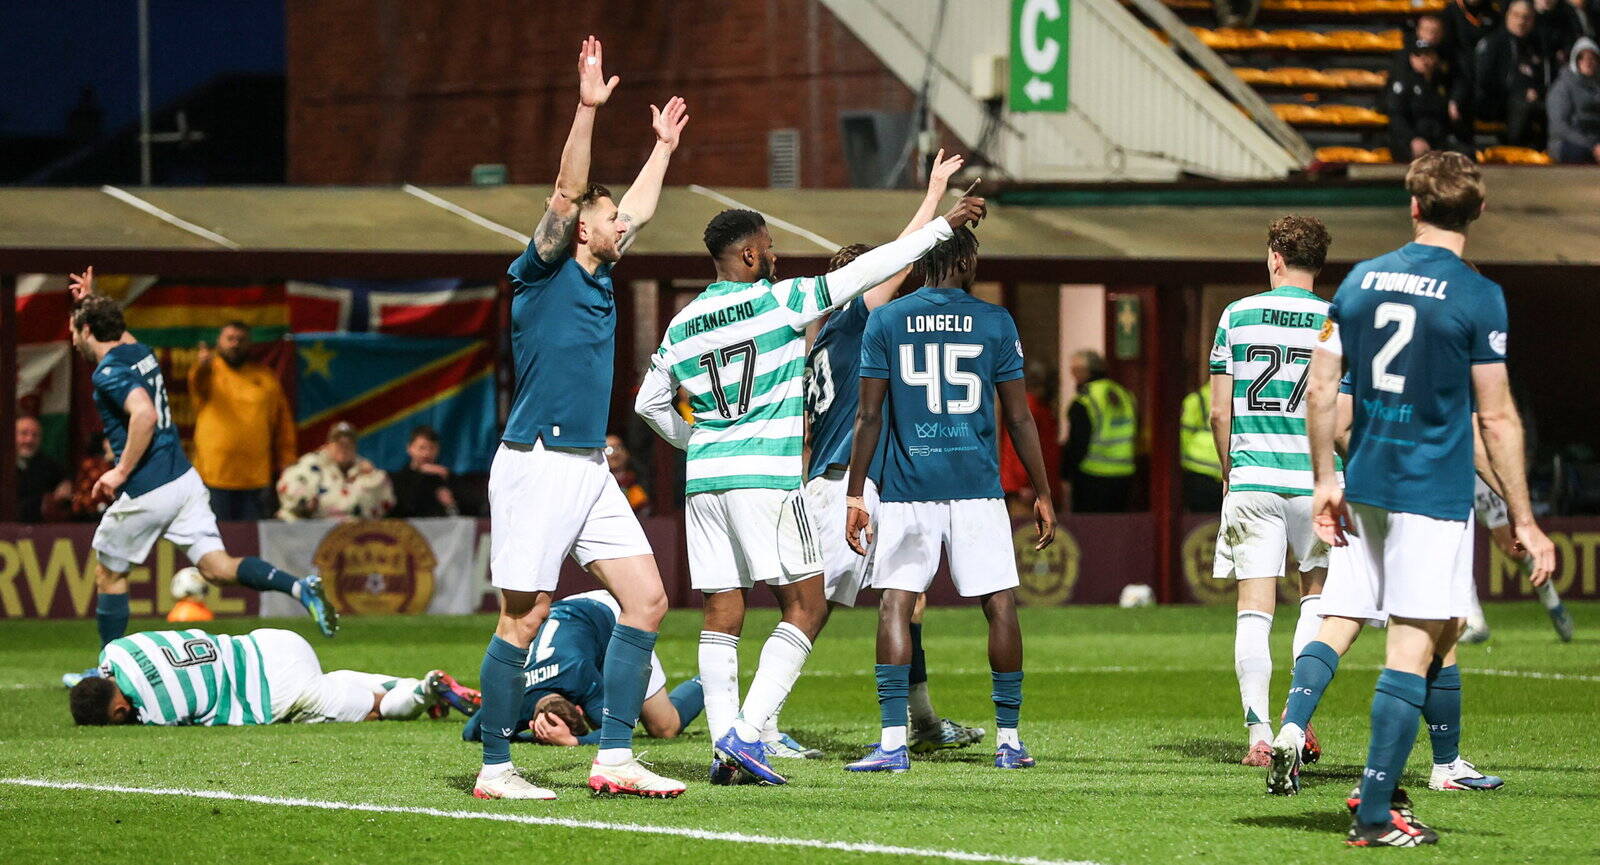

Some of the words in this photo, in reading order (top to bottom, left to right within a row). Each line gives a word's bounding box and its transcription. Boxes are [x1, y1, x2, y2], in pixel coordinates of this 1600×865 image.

[1020, 0, 1060, 73] C
[1360, 271, 1449, 301] O'DONNELL
[685, 301, 755, 337] IHEANACHO
[906, 314, 973, 333] LONGELO
[1262, 308, 1315, 329] ENGELS
[1371, 301, 1418, 395] 2
[699, 338, 758, 419] 17
[898, 342, 984, 415] 45
[1246, 344, 1312, 414] 27
[939, 422, 969, 438] kwiff
[131, 648, 164, 688] TRUSTY
[1428, 724, 1449, 732] FC
